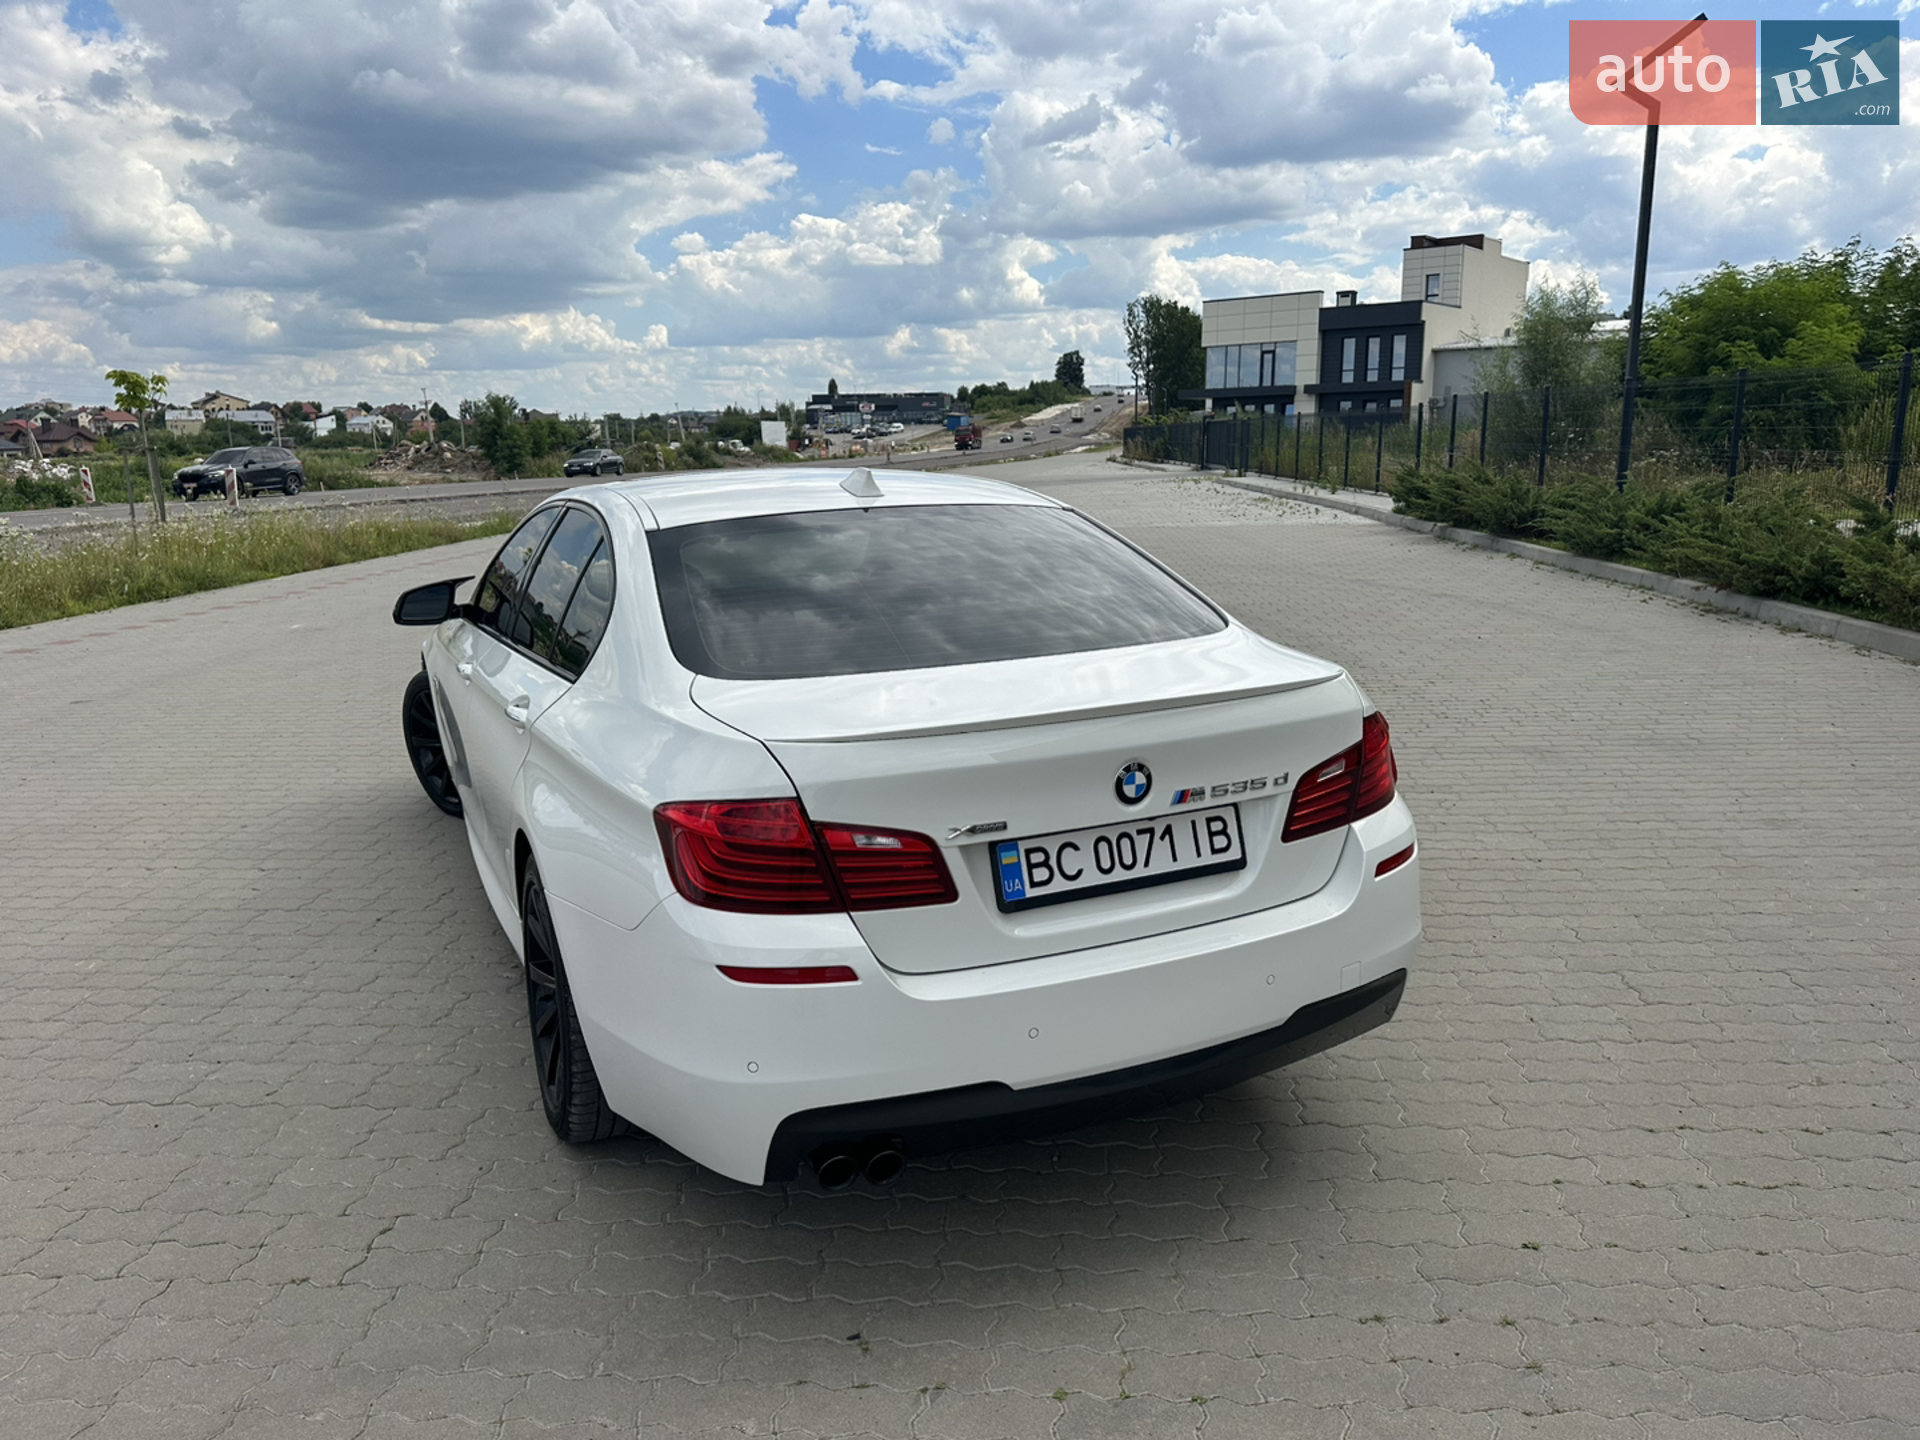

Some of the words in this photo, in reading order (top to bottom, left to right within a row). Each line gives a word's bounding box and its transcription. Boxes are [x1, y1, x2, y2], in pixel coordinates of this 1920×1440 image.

[1023, 841, 1084, 889] BC
[1093, 823, 1178, 875] 0071
[1190, 815, 1232, 858] IB
[1004, 878, 1023, 893] UA
